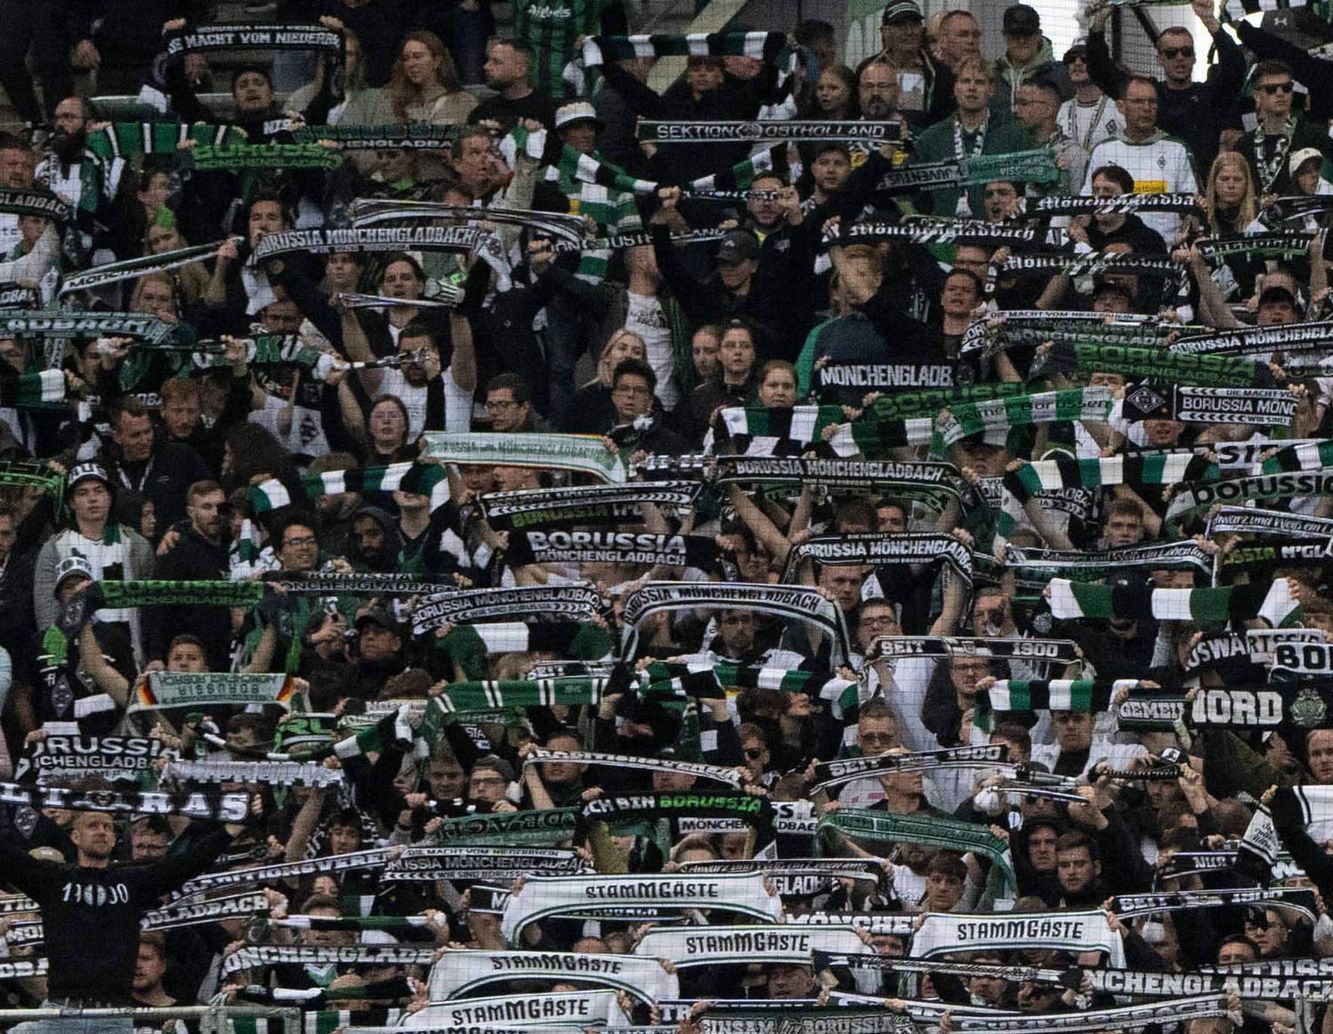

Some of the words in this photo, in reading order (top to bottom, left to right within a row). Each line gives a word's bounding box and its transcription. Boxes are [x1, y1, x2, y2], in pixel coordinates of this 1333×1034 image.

[656, 125, 734, 138] SEKTION
[767, 122, 885, 138] OSTHOLLAND
[1183, 398, 1251, 413] BORUSSIA
[527, 532, 684, 553] BORUSSIA
[882, 640, 925, 656] SEIT
[1010, 642, 1059, 657] 1900
[618, 795, 654, 812] BIN
[660, 793, 761, 813] BORUSSIA
[585, 881, 719, 900] STAMMGÄSTE
[957, 919, 1083, 941] STAMMGÄSTE
[687, 932, 810, 955] STAMMGÄSTE
[492, 953, 622, 977] STAMMGÄSTE
[452, 999, 588, 1026] STAMMGÄSTE
